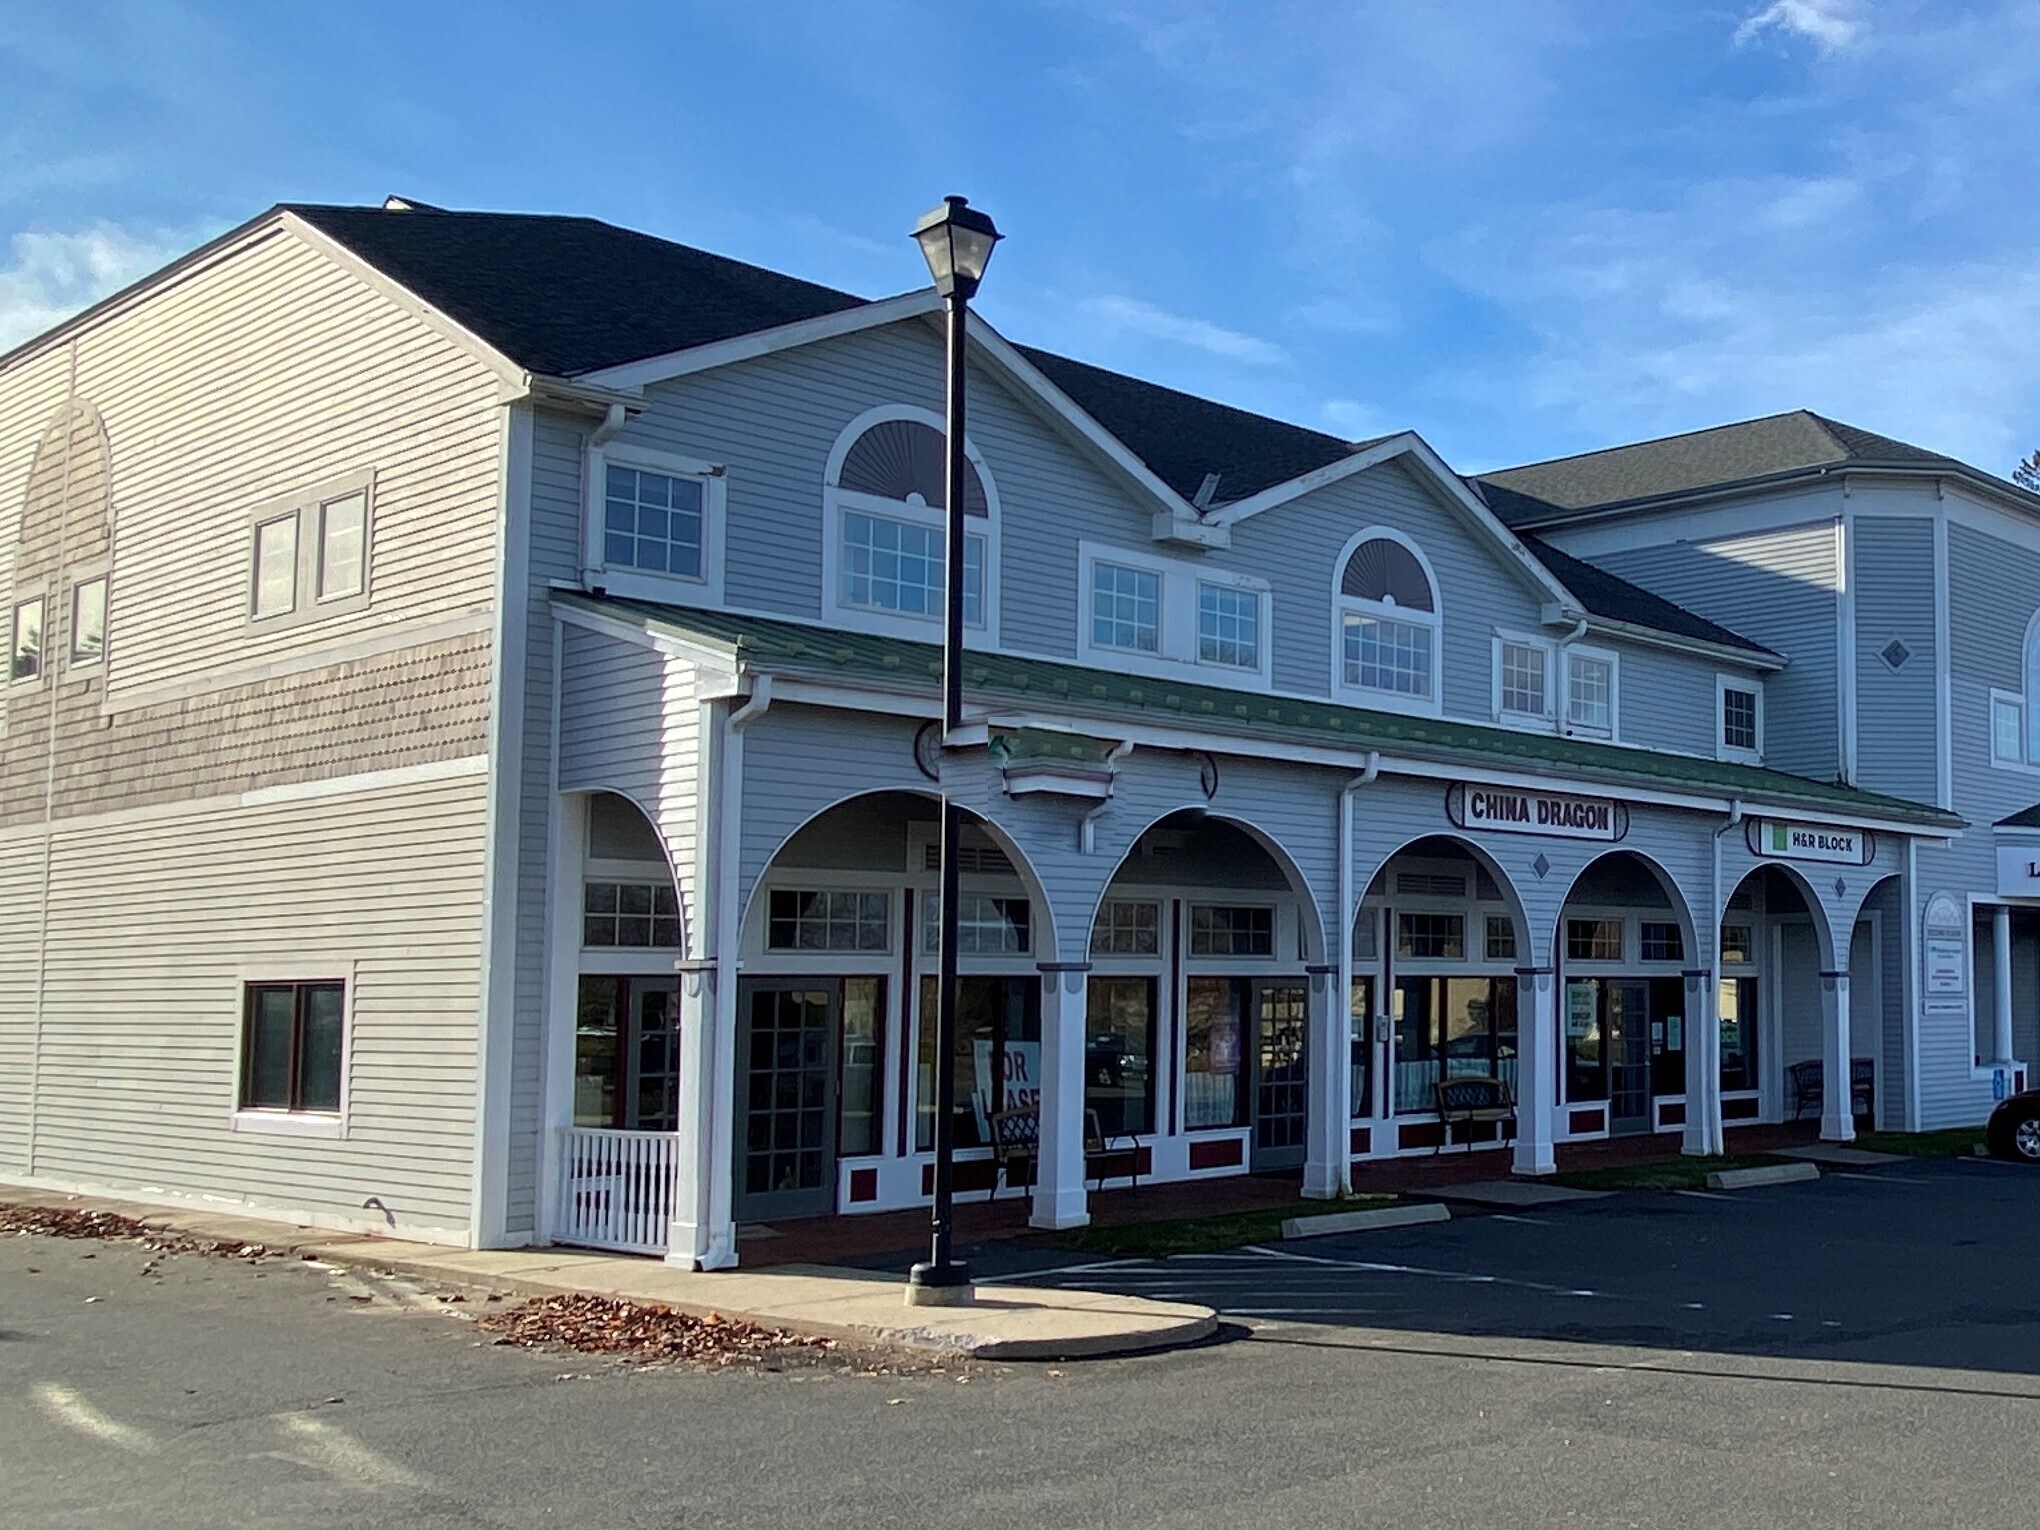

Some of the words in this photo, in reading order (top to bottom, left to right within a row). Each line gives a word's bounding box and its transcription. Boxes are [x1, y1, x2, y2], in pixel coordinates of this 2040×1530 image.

[1471, 792, 1530, 823] CHINA
[1537, 799, 1609, 830] DRAGON
[1792, 832, 1816, 848] H&R
[1818, 835, 1853, 852] BLOCK
[988, 1050, 1029, 1082] OR
